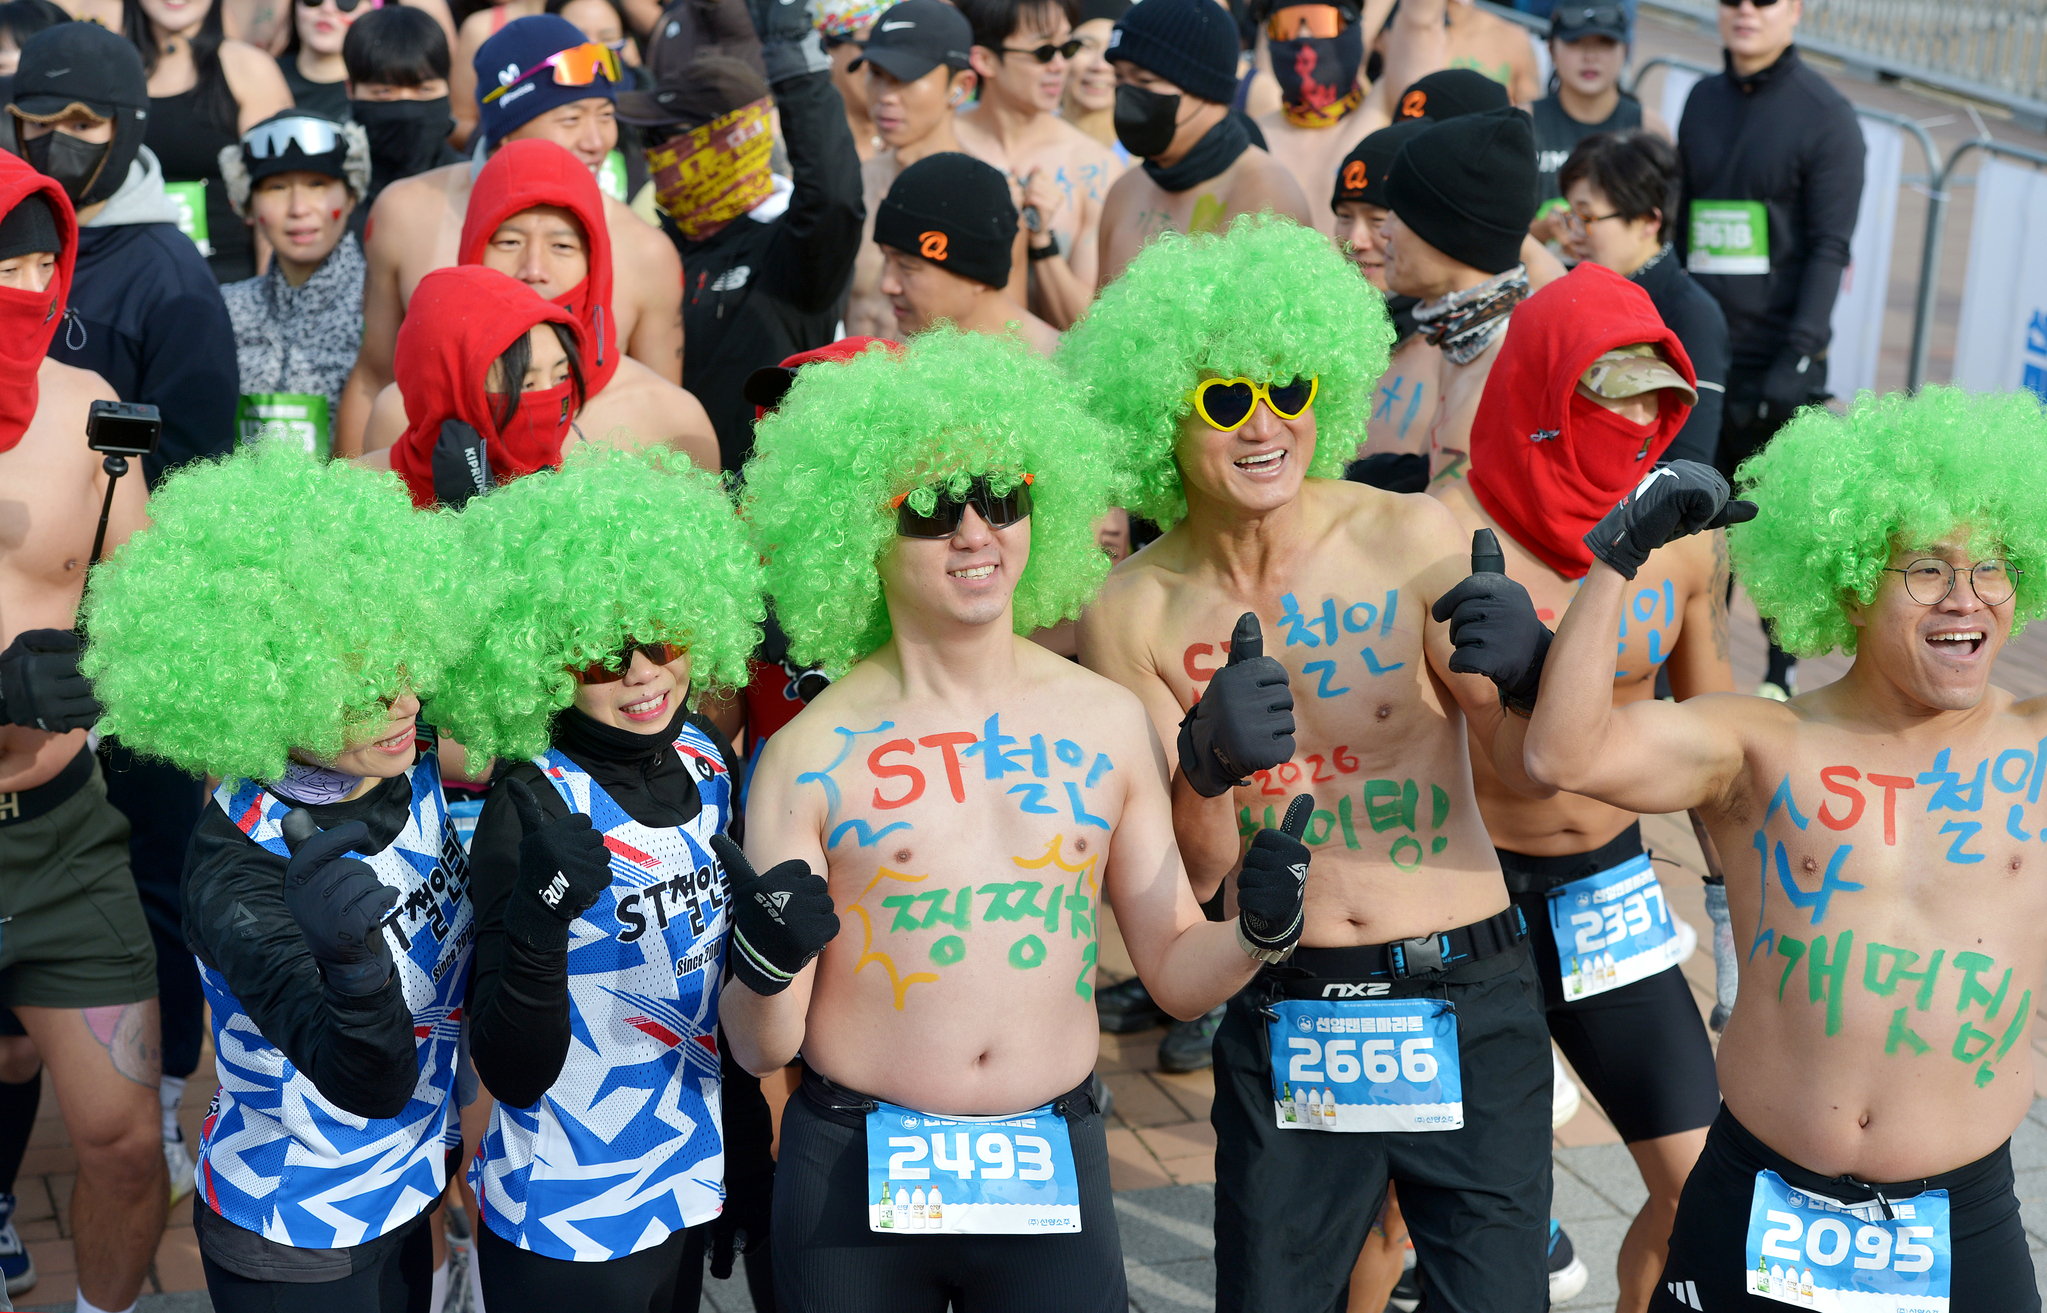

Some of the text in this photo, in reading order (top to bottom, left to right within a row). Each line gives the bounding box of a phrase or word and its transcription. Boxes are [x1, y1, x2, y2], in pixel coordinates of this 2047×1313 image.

[1253, 745, 1360, 796] 2026
[1570, 884, 1668, 955] 2337
[1288, 1037, 1439, 1084] 2666
[888, 1132, 1056, 1181] 2493
[1761, 1208, 1934, 1273] 2095
